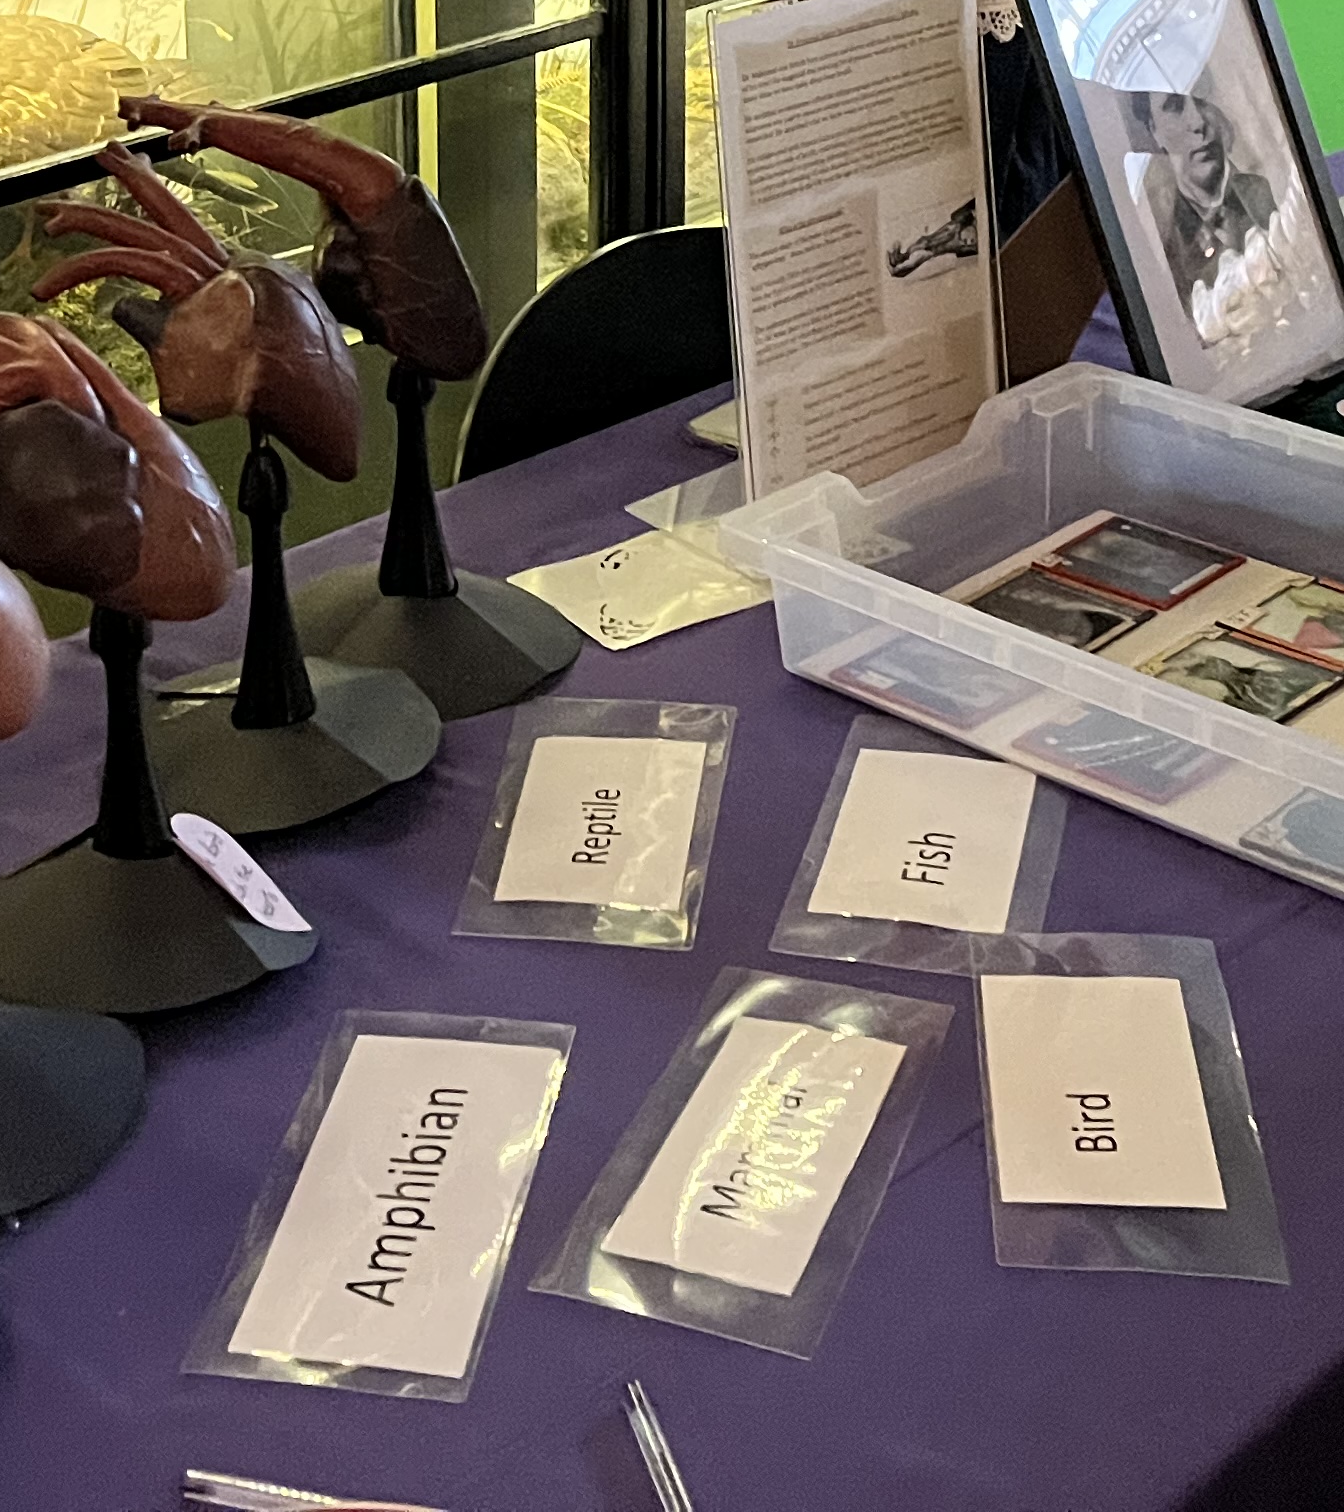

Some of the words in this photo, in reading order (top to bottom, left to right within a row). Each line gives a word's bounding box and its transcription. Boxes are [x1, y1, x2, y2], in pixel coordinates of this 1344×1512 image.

[571, 789, 622, 864] Reptile
[901, 833, 957, 886] Fish
[1064, 1093, 1118, 1152] Bird
[345, 1088, 469, 1308] Amphibian
